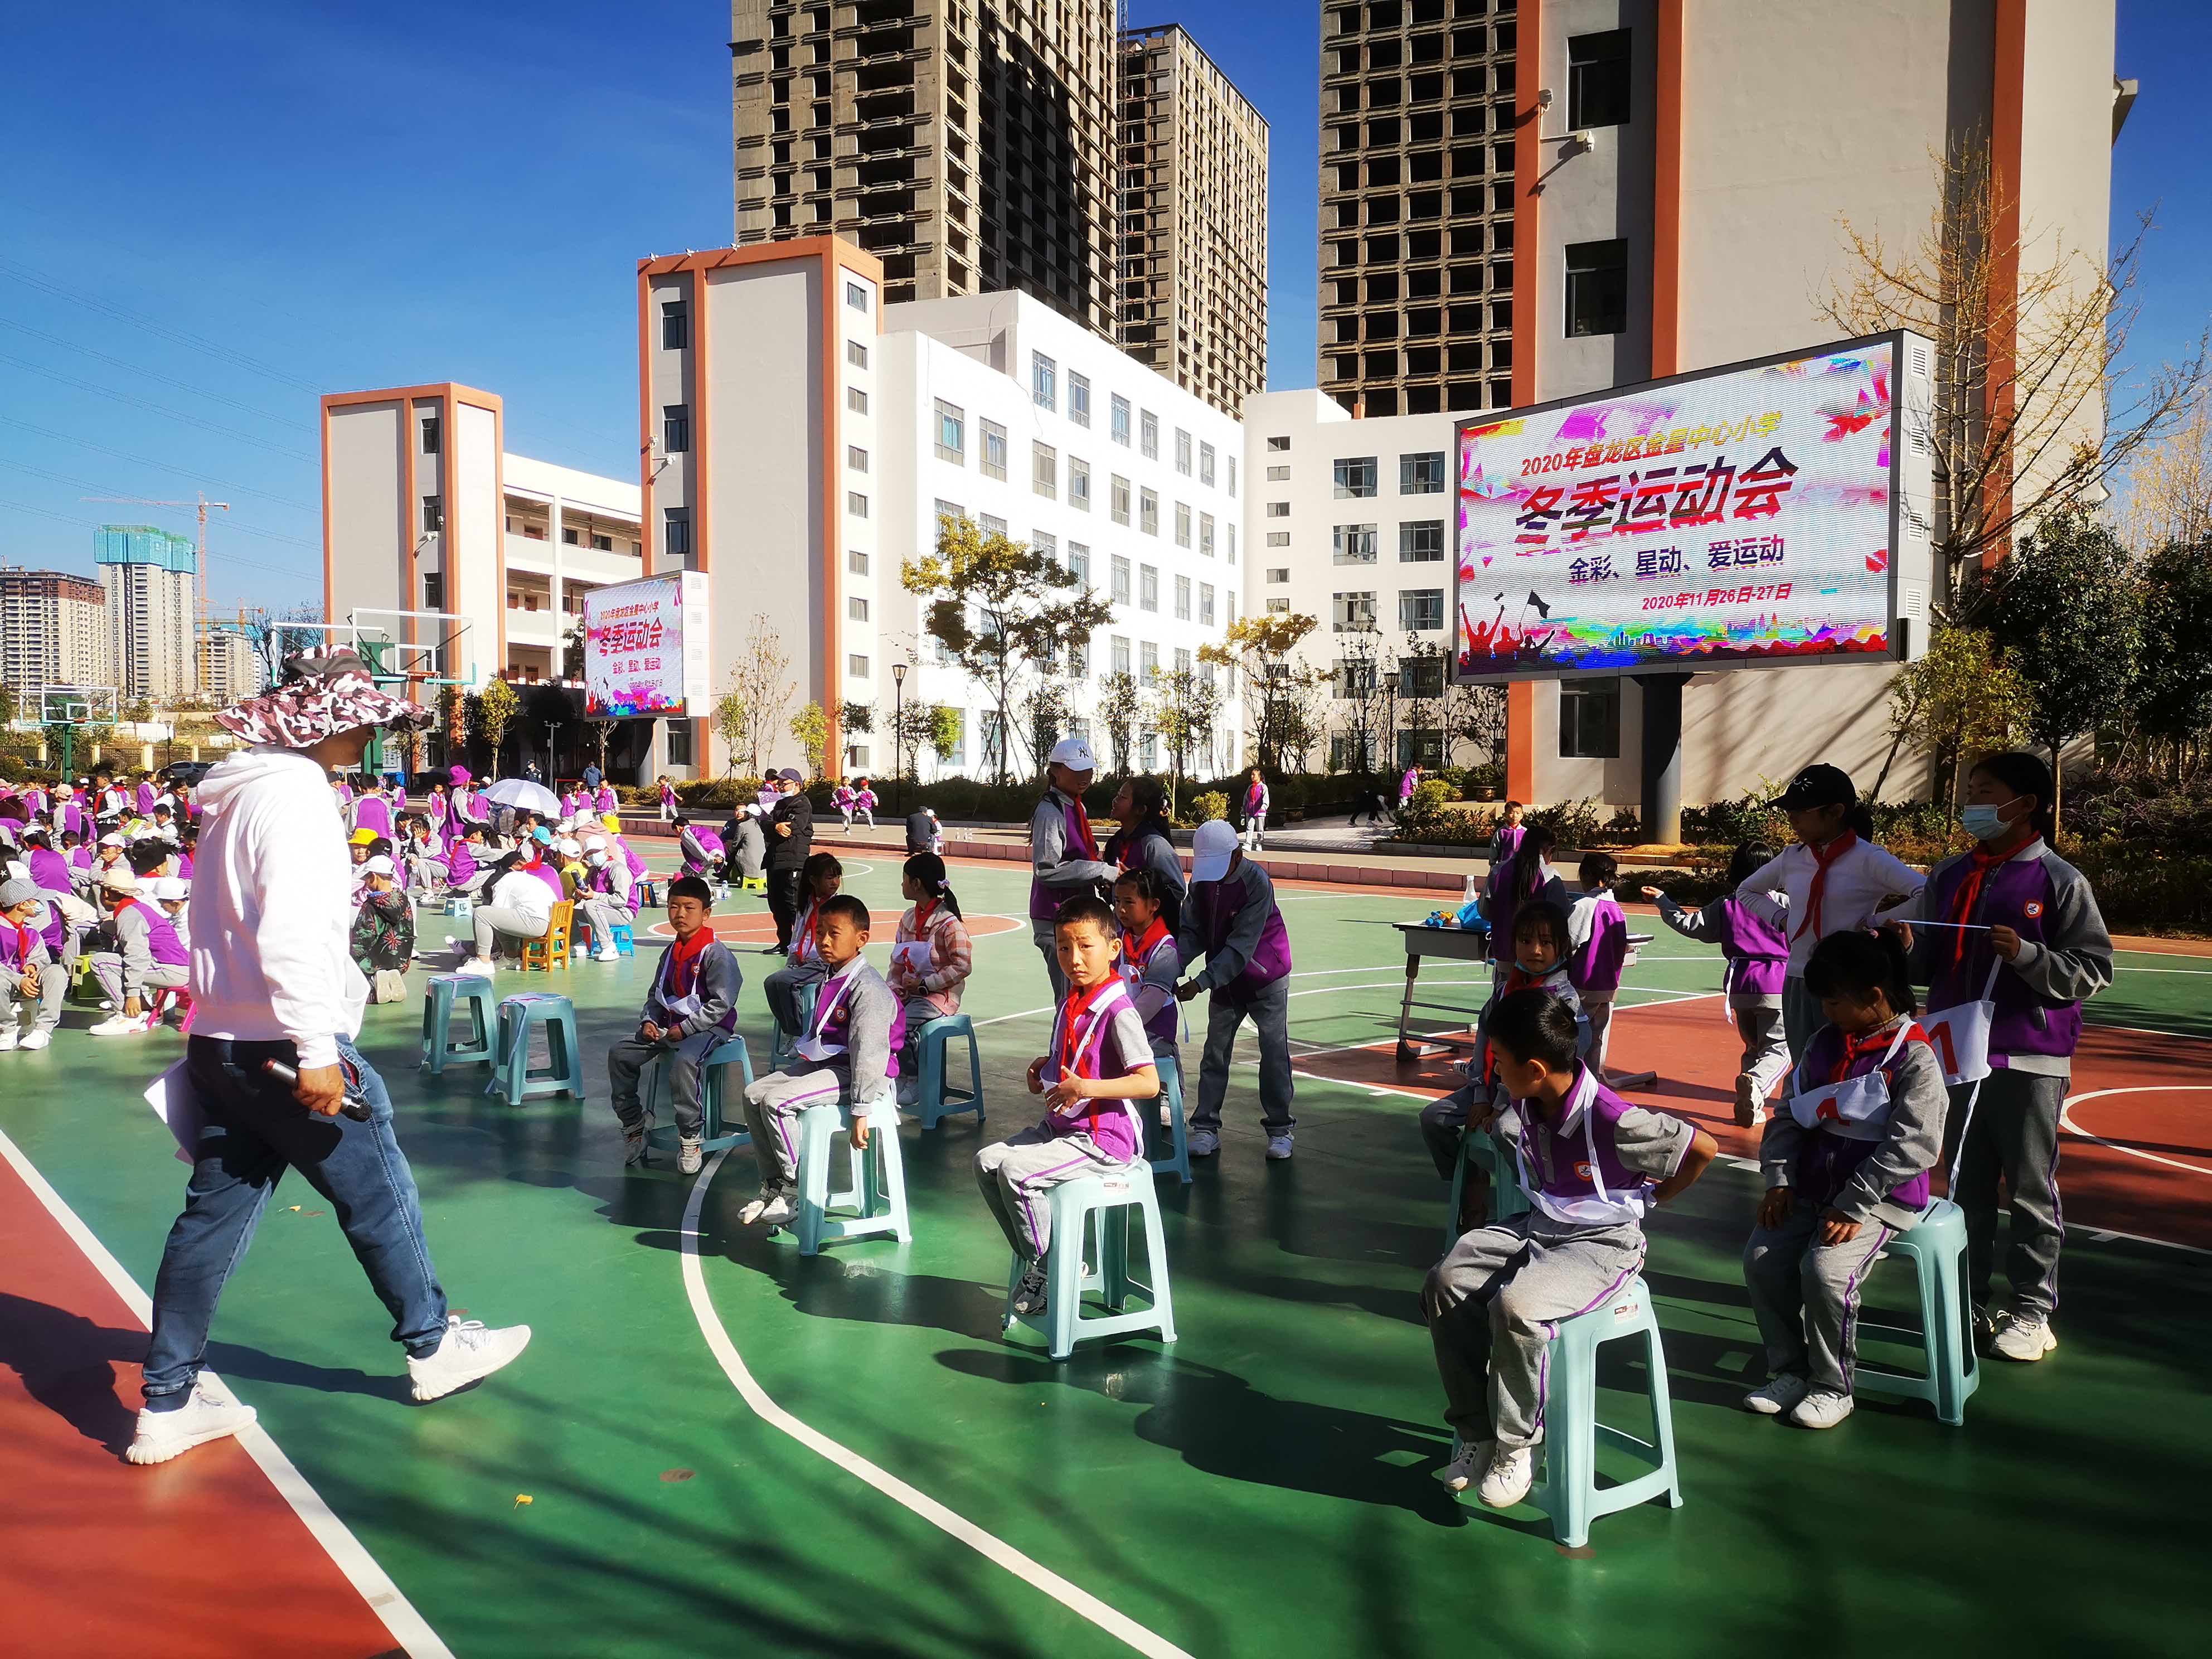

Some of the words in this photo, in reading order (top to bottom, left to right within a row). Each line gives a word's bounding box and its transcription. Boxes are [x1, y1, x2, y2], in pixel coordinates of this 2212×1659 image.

[1521, 410, 1783, 477] 2020年盘龙区金星中心小学
[1514, 446, 1799, 544] 冬季运动会
[1642, 583, 1793, 610] 2020年11月26日-27日
[599, 617, 663, 656] 冬季运动会
[1928, 1021, 1959, 1075] 1
